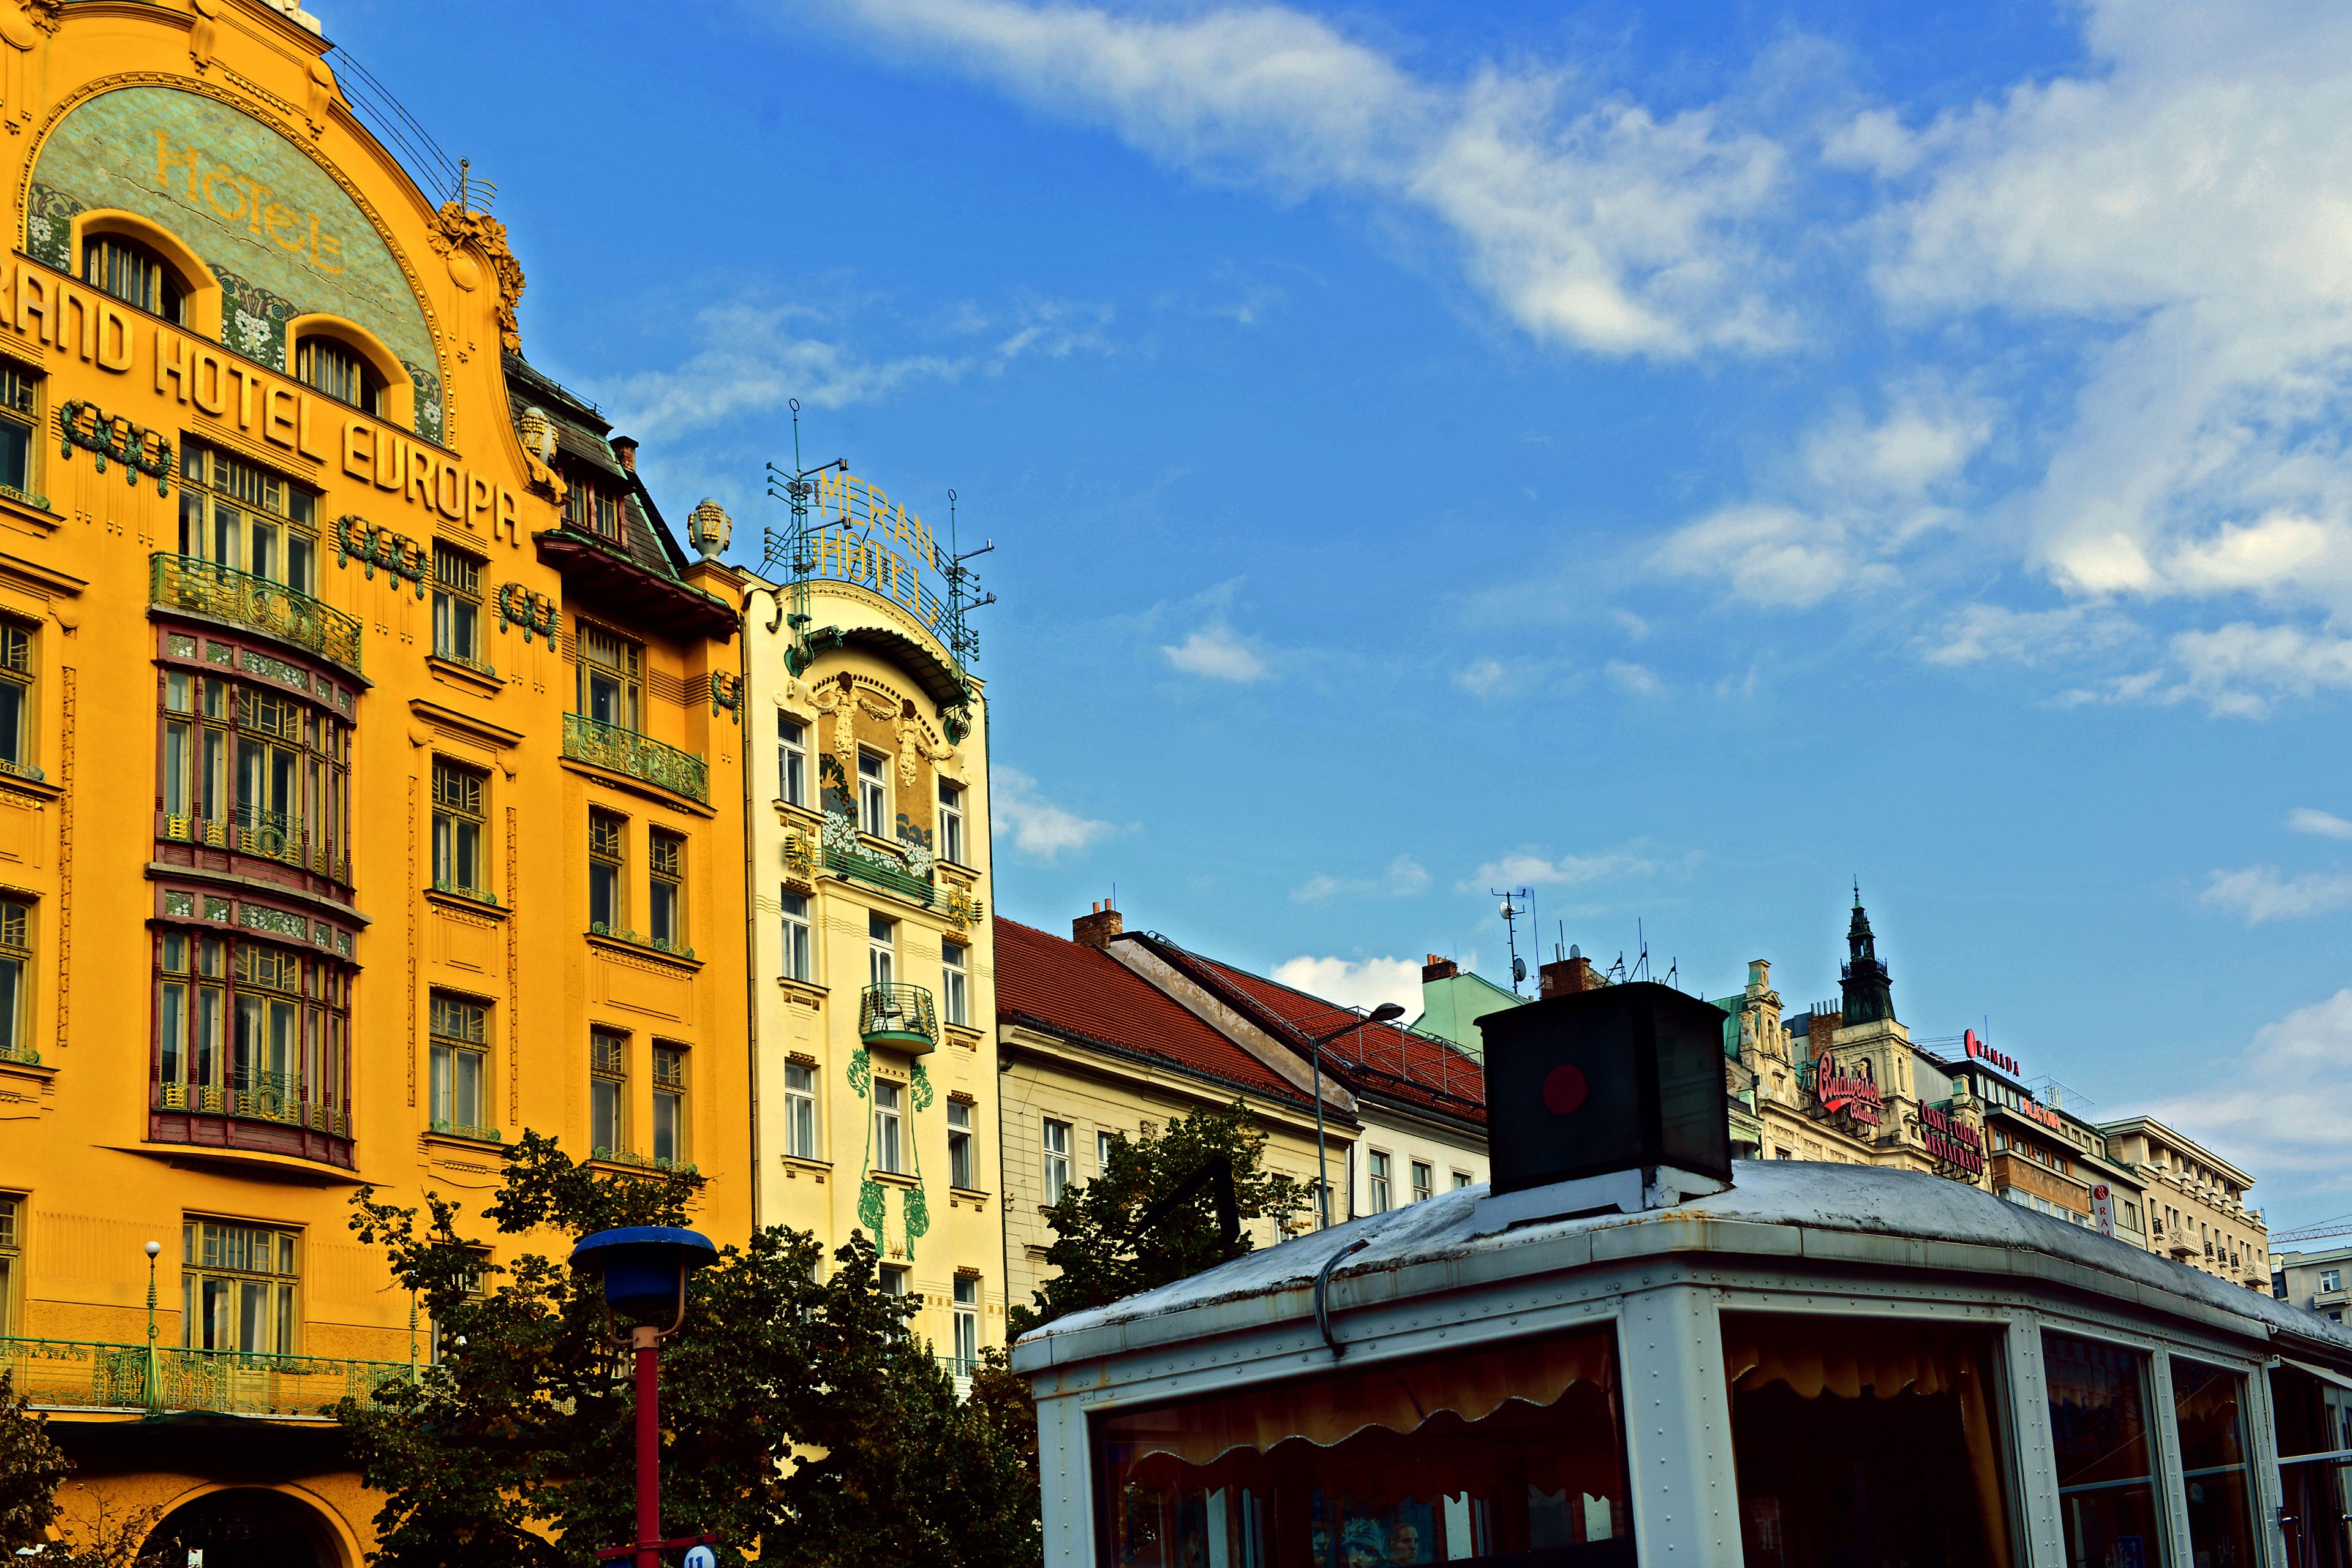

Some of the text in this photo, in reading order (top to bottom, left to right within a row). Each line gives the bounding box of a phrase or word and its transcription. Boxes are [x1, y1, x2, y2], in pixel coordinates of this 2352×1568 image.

[156, 327, 328, 464] HOTEL
[343, 418, 521, 546] EUROPA
[820, 469, 935, 572] MERAN
[820, 527, 934, 628] HOTEL
[1819, 1051, 1882, 1106] Budweiser
[1975, 1040, 2020, 1077] RAMADA
[1922, 1101, 1947, 1132] ČESKÝ
[1954, 1120, 1978, 1147] CZECH
[1925, 1132, 1981, 1175] RESTAURANT
[2183, 1155, 2242, 1200] HOTEL
[688, 1556, 703, 1568] 11
